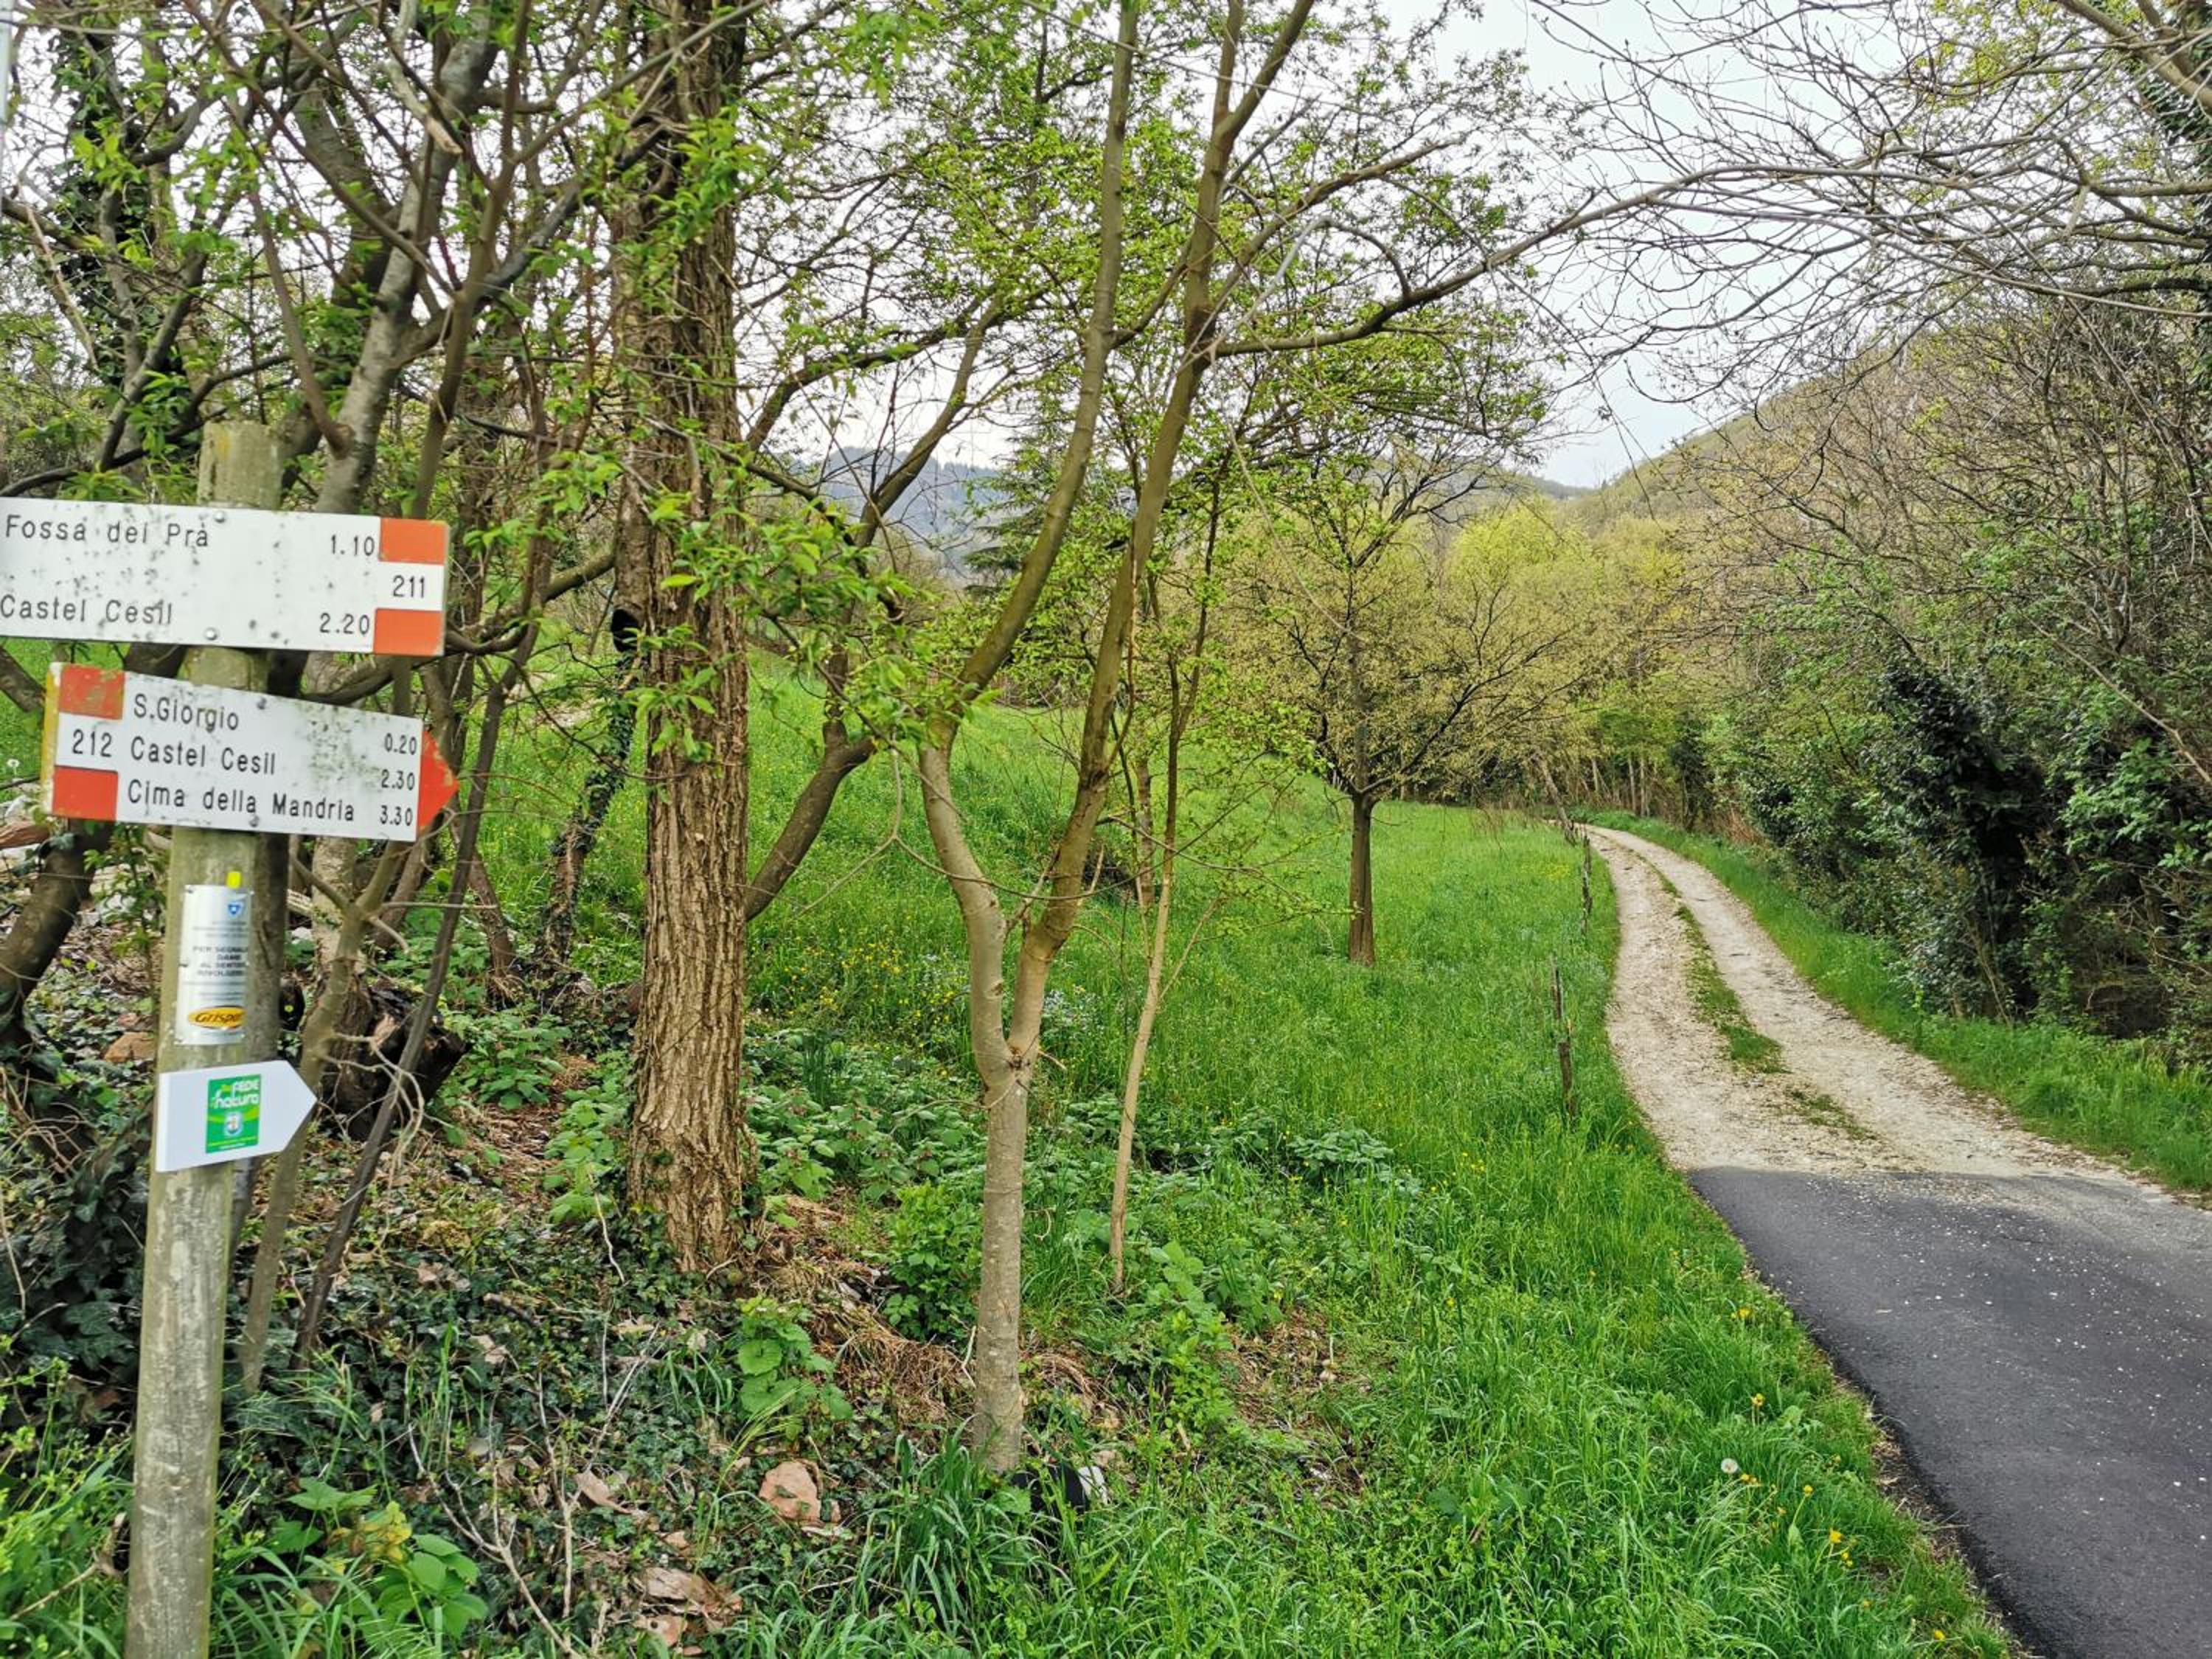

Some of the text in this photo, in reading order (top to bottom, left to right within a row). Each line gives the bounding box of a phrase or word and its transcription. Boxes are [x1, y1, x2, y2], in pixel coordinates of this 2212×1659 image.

[5, 514, 86, 541] Fossa
[107, 521, 148, 543] del
[330, 535, 375, 557] 1.10
[392, 575, 426, 598] 211
[0, 594, 370, 635] Castel Cesil 2.20
[72, 728, 113, 758] 212
[133, 694, 417, 755] S.Giorgio 0.20
[130, 737, 415, 791] Castel Cesil 2.30
[128, 779, 414, 827] Cima della Mandria 3.30
